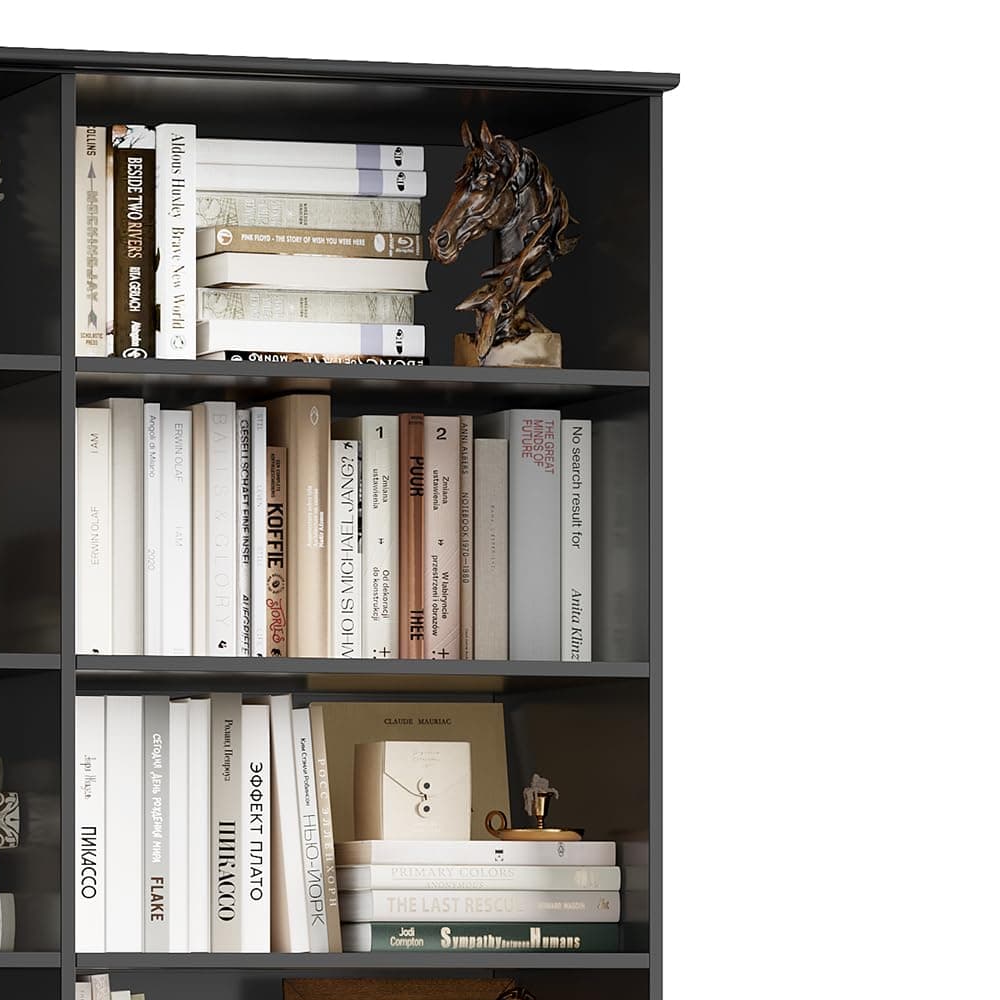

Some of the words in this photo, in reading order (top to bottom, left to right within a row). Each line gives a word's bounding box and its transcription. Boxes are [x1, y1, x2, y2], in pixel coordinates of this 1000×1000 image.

[86, 127, 97, 156] OLLINS
[170, 132, 186, 175] Aldous
[127, 157, 143, 192] BESIDE
[127, 193, 143, 220] TWO
[168, 177, 186, 218] Huxley
[127, 222, 143, 259] RIVERS
[171, 227, 186, 261] Brave
[241, 233, 253, 241] PINK
[254, 233, 271, 242] FLOYD
[275, 234, 285, 242] THE
[286, 235, 302, 243] STORY
[311, 236, 325, 244] WISH
[326, 237, 337, 245] YOU
[338, 237, 351, 246] WERE
[352, 237, 365, 246] HERE
[171, 265, 186, 289] New
[171, 294, 186, 329] World
[248, 352, 288, 363] MUNRO
[90, 432, 99, 448] AM
[148, 415, 156, 441] Angoli
[175, 423, 183, 454] ERWIN
[375, 426, 384, 439] 1
[436, 427, 447, 440] 2
[461, 423, 469, 444] ANNI
[522, 419, 533, 459] FUTURE
[533, 419, 544, 450] MINDS
[544, 420, 554, 441] THE
[572, 426, 583, 445] No
[175, 456, 183, 482] OLAF
[534, 450, 544, 467] OF
[545, 441, 554, 475] GREAT
[571, 447, 582, 490] search
[341, 456, 354, 513] JANG?
[410, 456, 424, 497] PUUR
[91, 506, 99, 531] OLAF
[571, 493, 582, 528] result
[91, 533, 99, 566] ERWIN
[267, 503, 283, 569] KOFFIE
[571, 533, 582, 549] for
[341, 515, 354, 593] MICHAEL
[373, 567, 379, 576] do
[382, 569, 390, 580] Od
[431, 554, 439, 598] przestrzeni
[442, 571, 449, 580] W
[341, 599, 354, 613] IS
[382, 581, 390, 619] dekoracji
[440, 581, 449, 620] labiryncie
[571, 588, 583, 624] Anita
[341, 618, 354, 658] WHO
[410, 610, 424, 641] THEE
[571, 627, 583, 660] Klinz
[152, 733, 162, 769] СЕГОДНЯ
[150, 771, 163, 794] ДЕНЬ
[317, 758, 328, 800] РОСС
[250, 761, 263, 835] ЭФФЕКТ
[151, 797, 163, 839] РОЖДЕНИЯ
[81, 826, 97, 899] ПИКАССО
[151, 841, 163, 863] МИРА
[218, 821, 236, 922] ПИКАССО
[249, 841, 263, 901] ПЛАТО
[303, 814, 325, 926] НЬЮ-ЙОРК
[391, 867, 454, 878] PRIMARY
[459, 867, 515, 878] COLORS
[150, 876, 164, 922] FLAKE
[386, 896, 417, 912] THE
[421, 896, 460, 912] LAST
[389, 936, 424, 948] Compton
[398, 927, 415, 937] Jodi
[440, 926, 502, 949] Sympathy
[529, 926, 582, 949] Humans
